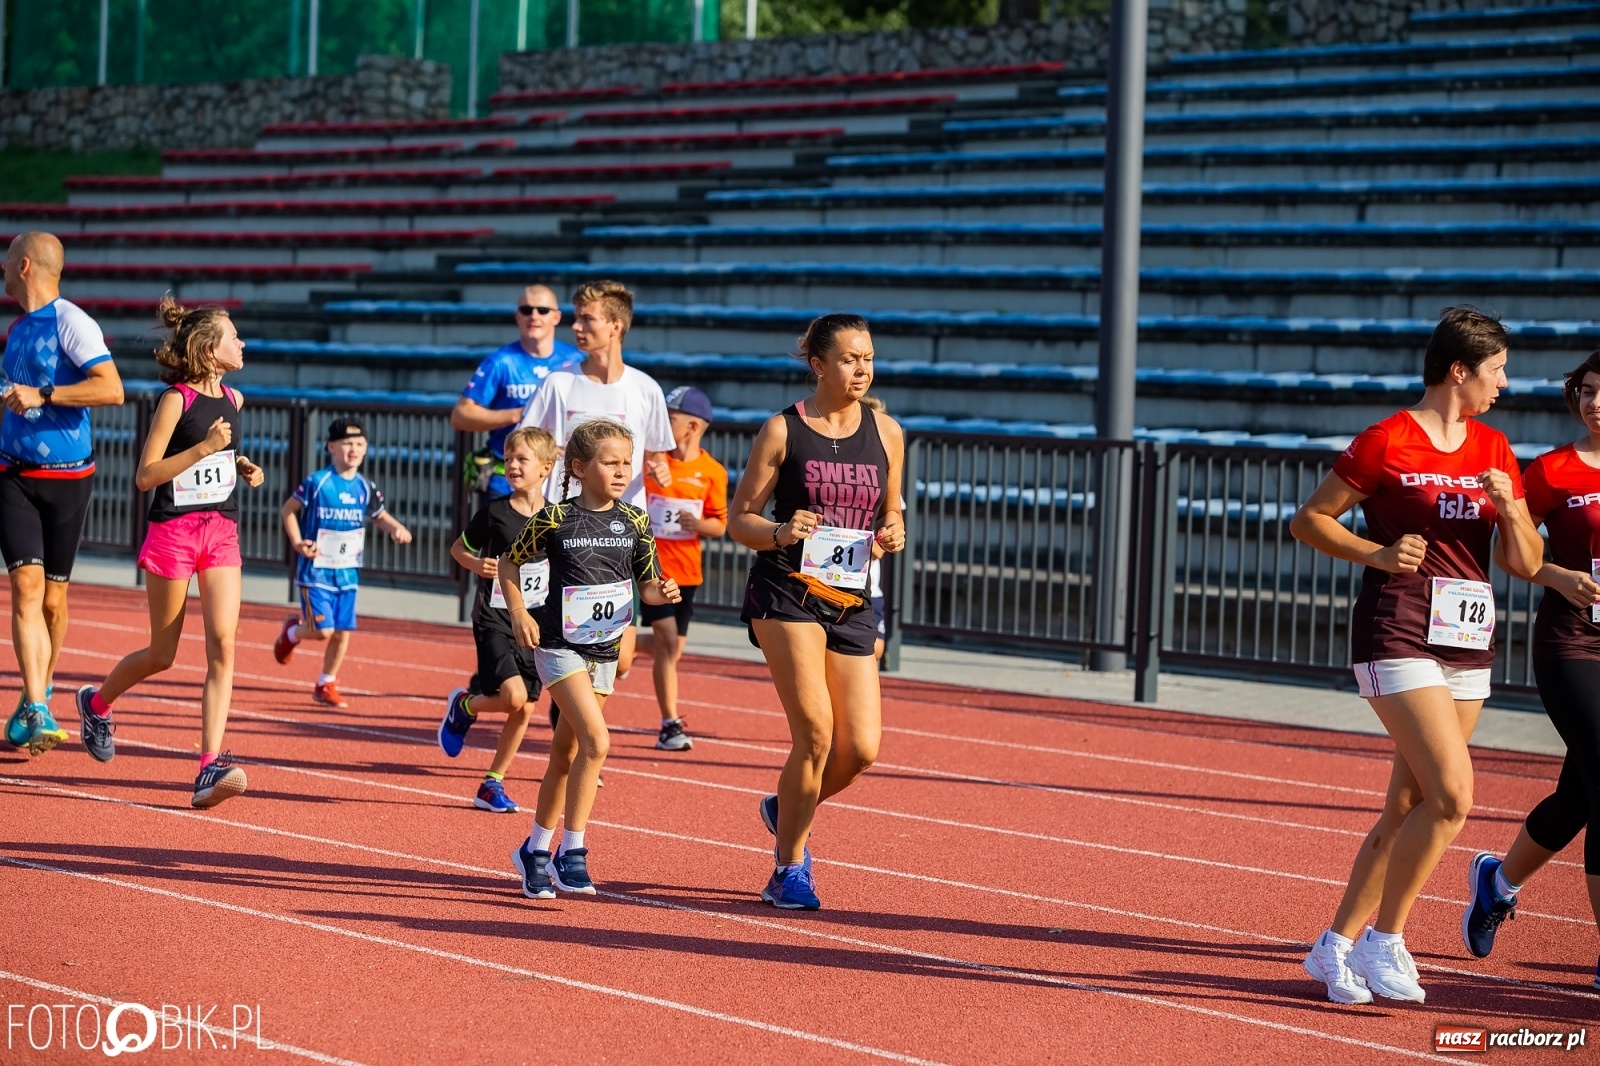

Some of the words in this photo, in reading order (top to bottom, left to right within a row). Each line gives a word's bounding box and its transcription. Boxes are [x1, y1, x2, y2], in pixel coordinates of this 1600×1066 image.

[194, 467, 221, 486] 151
[805, 460, 879, 487] SWEAT
[1400, 473, 1484, 489] DAR-B
[804, 482, 881, 511] TODAY
[339, 543, 347, 555] 8
[563, 538, 634, 549] RUNMAGEDDON
[831, 545, 854, 566] 81
[523, 576, 541, 592] 52
[592, 601, 615, 621] 80
[1458, 600, 1486, 624] 128
